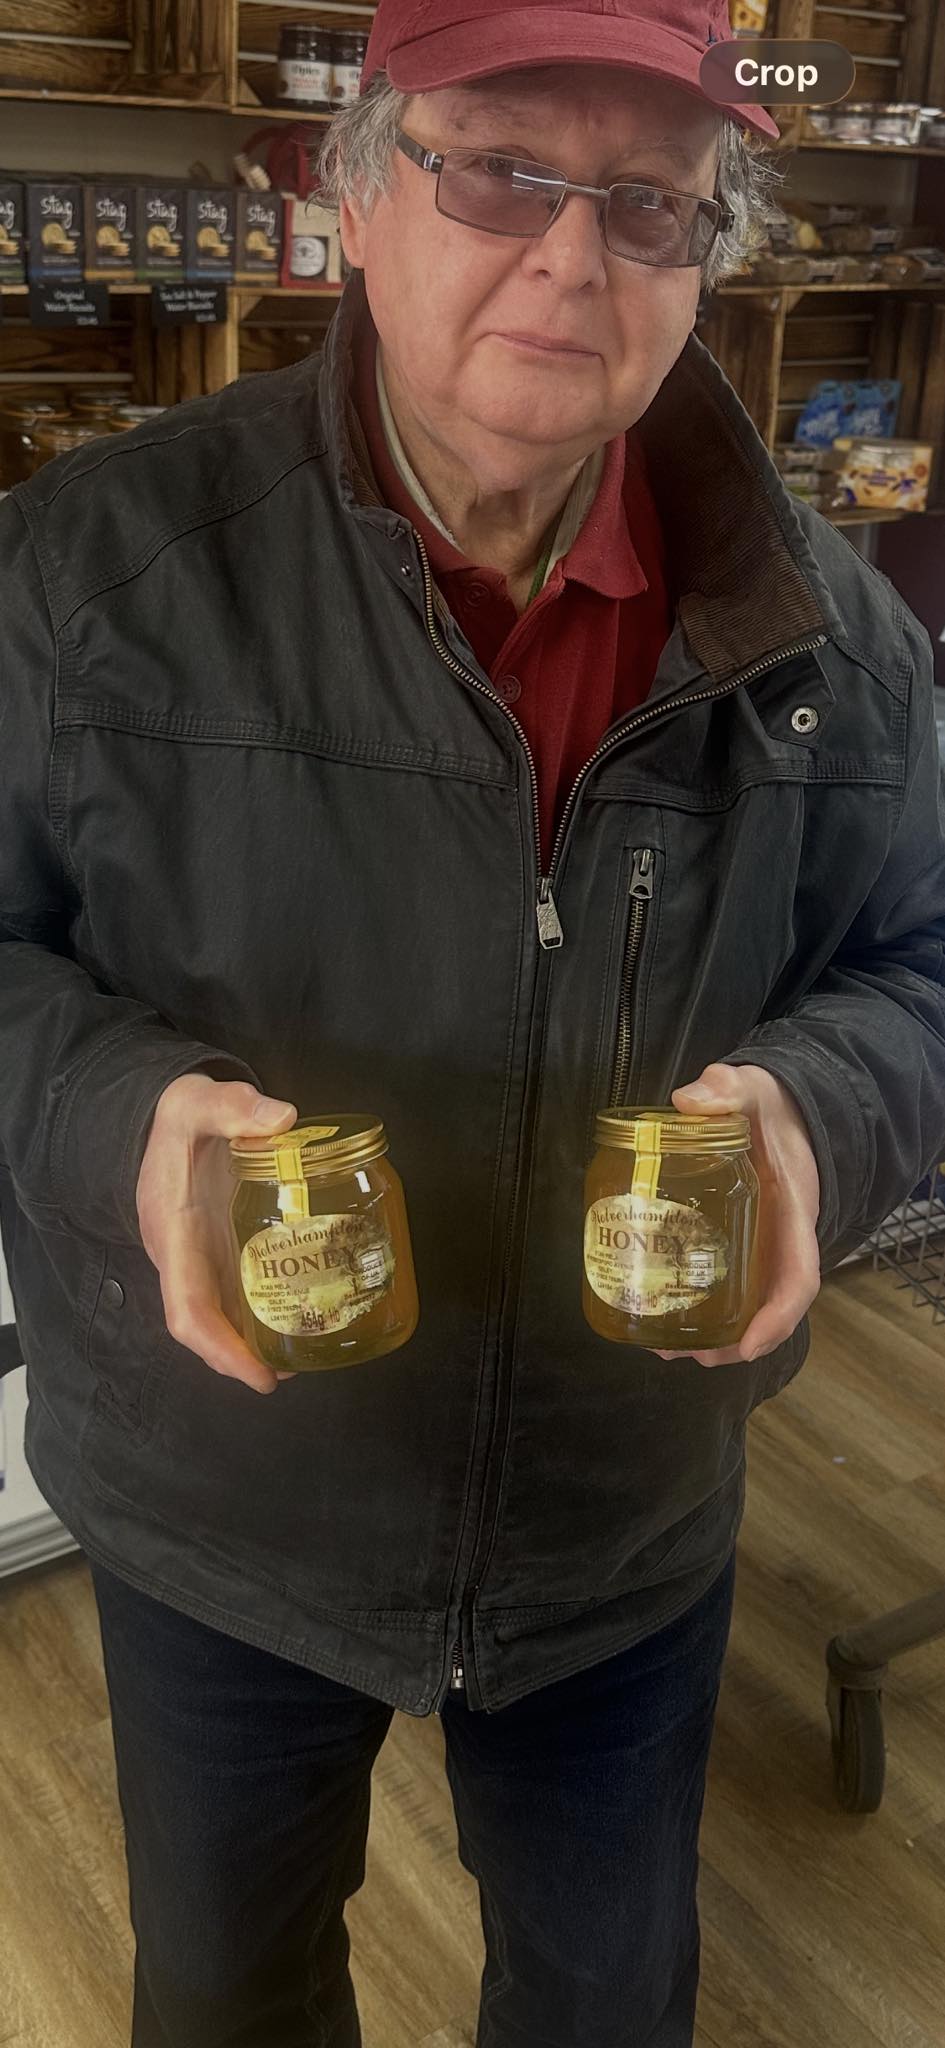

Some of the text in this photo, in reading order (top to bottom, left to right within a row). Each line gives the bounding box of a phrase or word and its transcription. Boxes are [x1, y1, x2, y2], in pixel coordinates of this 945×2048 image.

[591, 1205, 700, 1229] Wolverhampton
[248, 1219, 364, 1263] Wolverhampton
[599, 1226, 689, 1254] HONEY
[260, 1244, 361, 1279] HONEY
[301, 1310, 325, 1331] 454g
